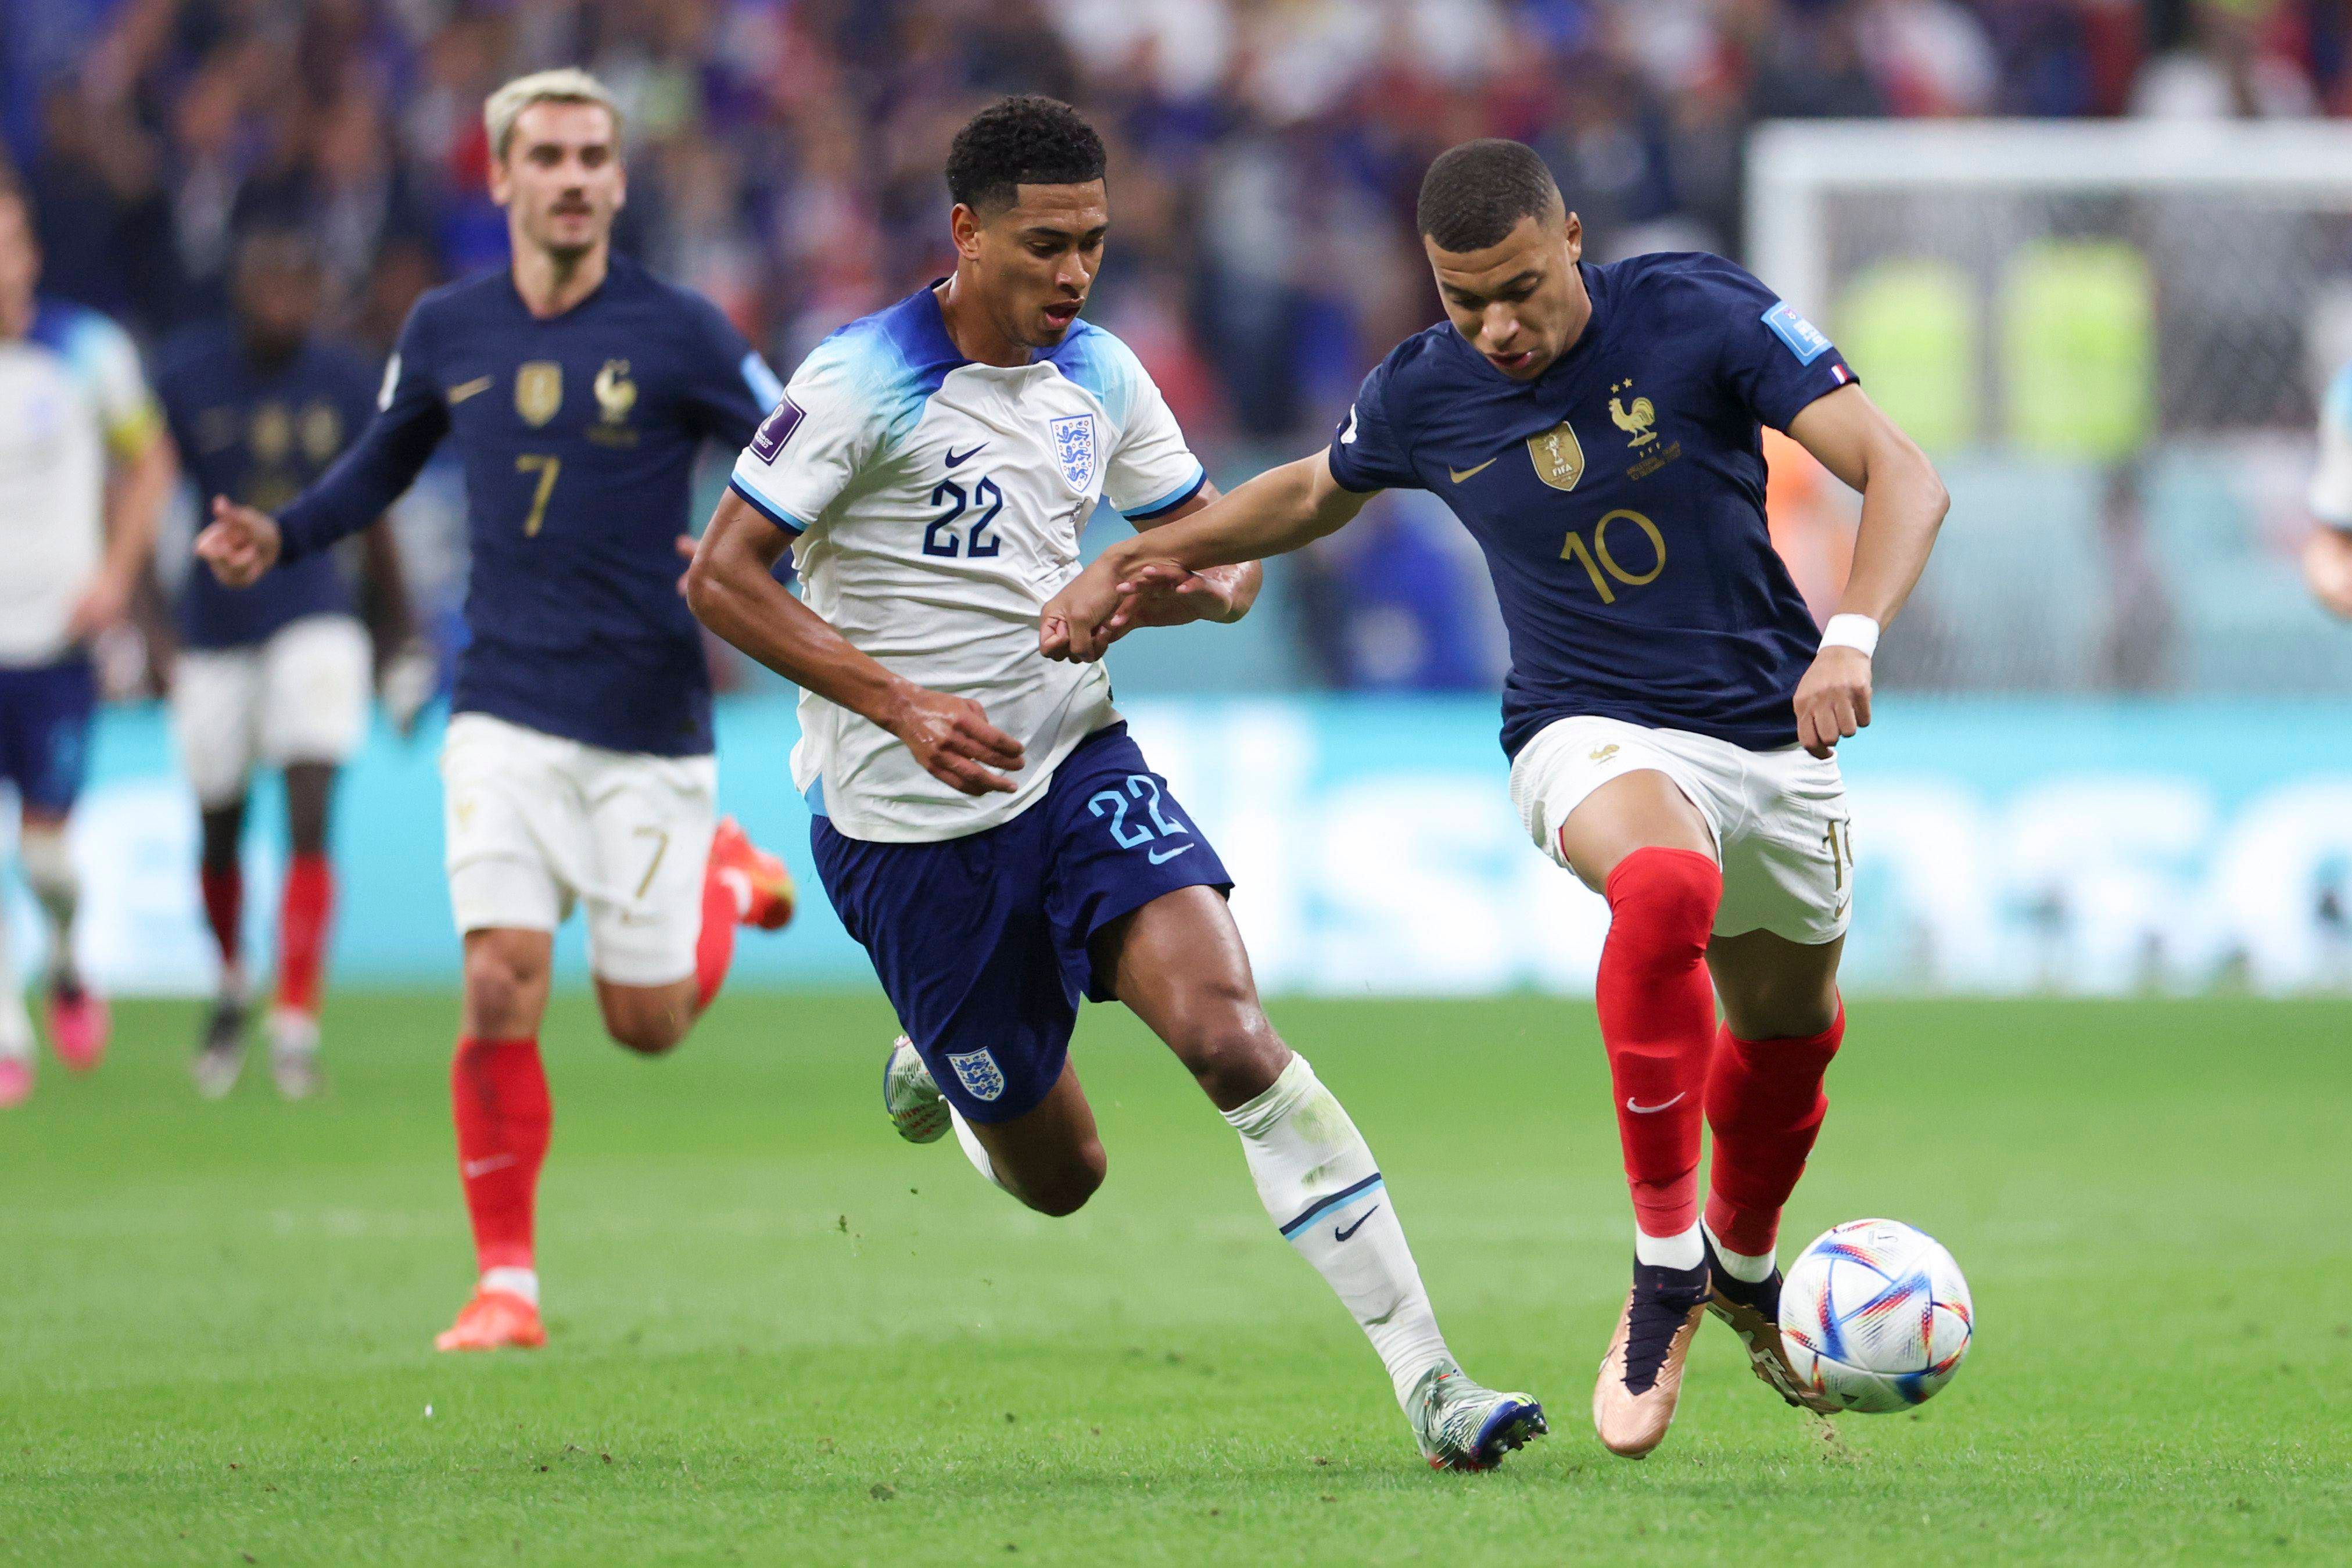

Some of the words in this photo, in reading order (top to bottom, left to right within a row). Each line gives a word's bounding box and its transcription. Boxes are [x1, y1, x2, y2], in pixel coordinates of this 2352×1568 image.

[516, 454, 561, 537] 7
[1552, 463, 1573, 476] FIFA
[923, 476, 1003, 558] 22
[1560, 508, 1666, 605] 10
[1088, 774, 1189, 849] 22
[632, 826, 669, 900] 7
